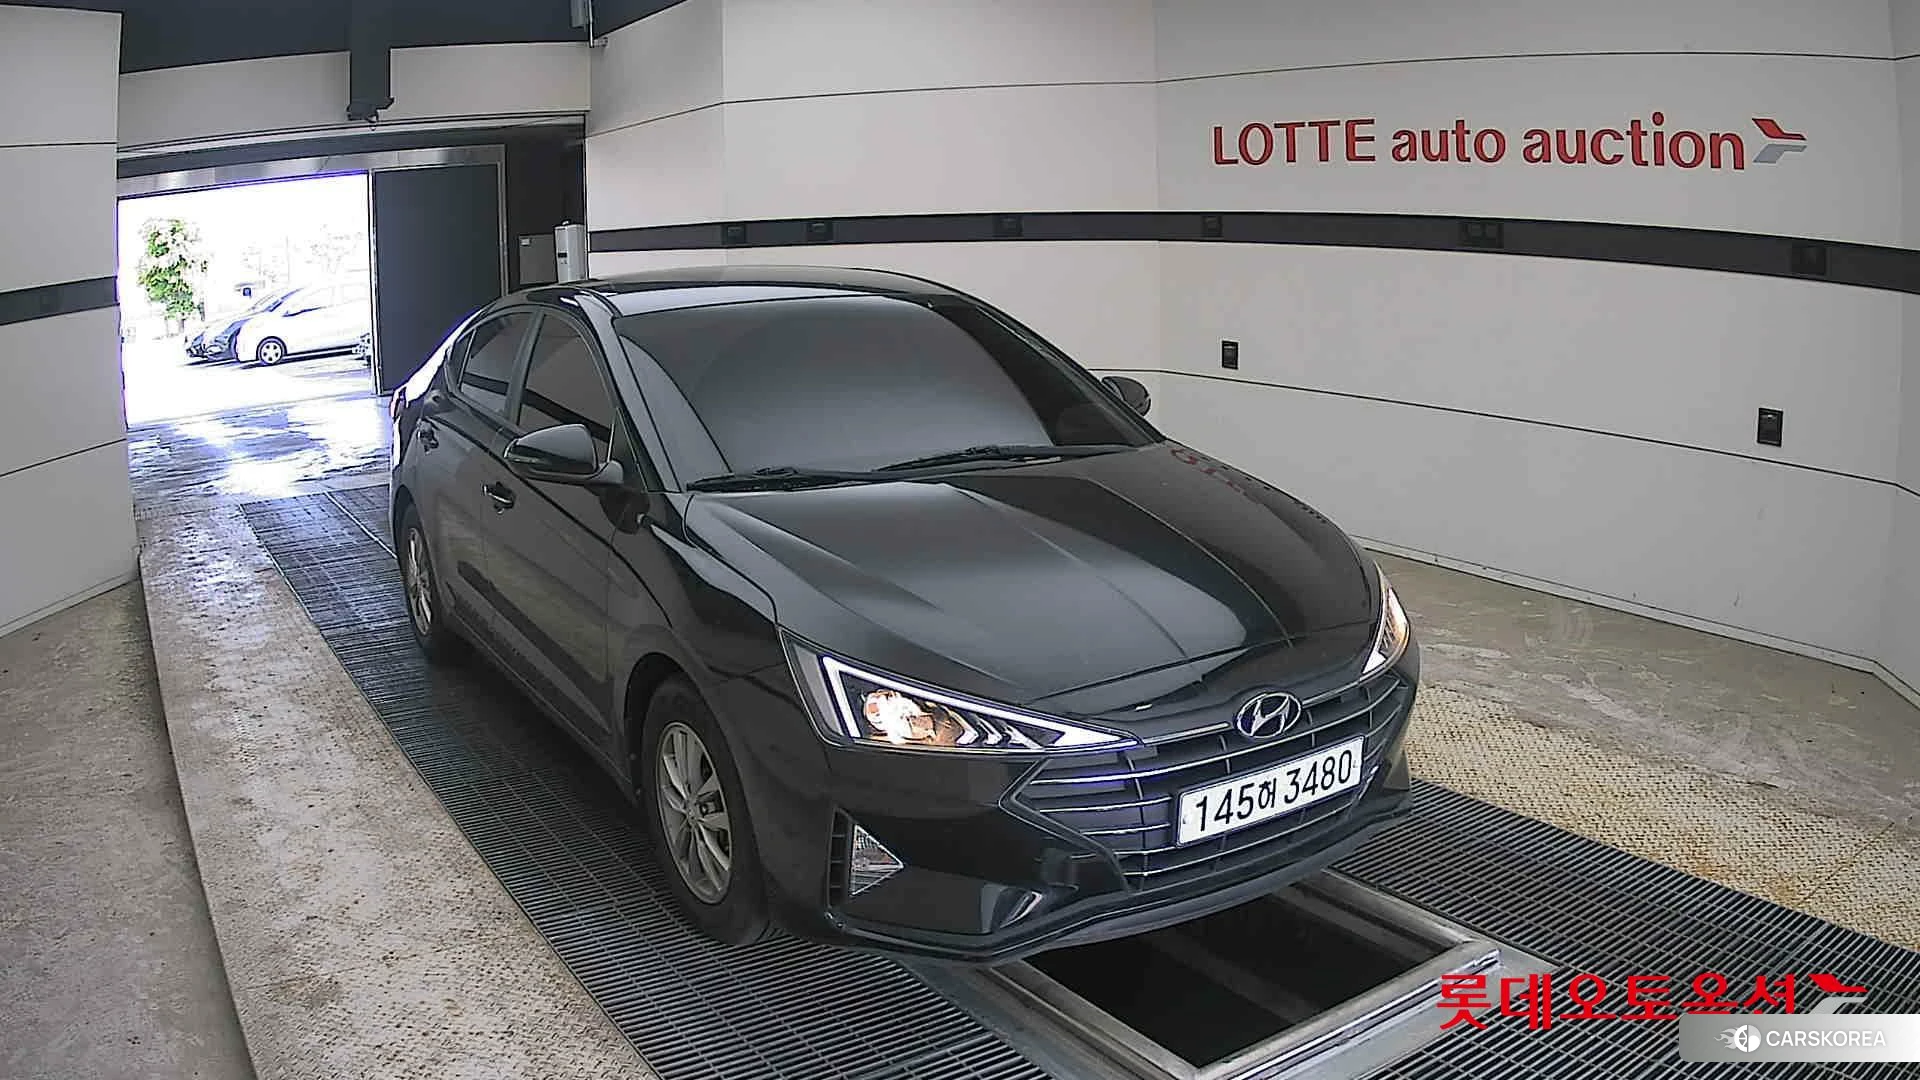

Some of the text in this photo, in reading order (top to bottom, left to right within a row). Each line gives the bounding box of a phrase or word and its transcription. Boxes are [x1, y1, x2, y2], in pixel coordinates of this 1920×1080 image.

[1213, 111, 1745, 170] LOTTE auto auction
[1284, 749, 1353, 804] 3480
